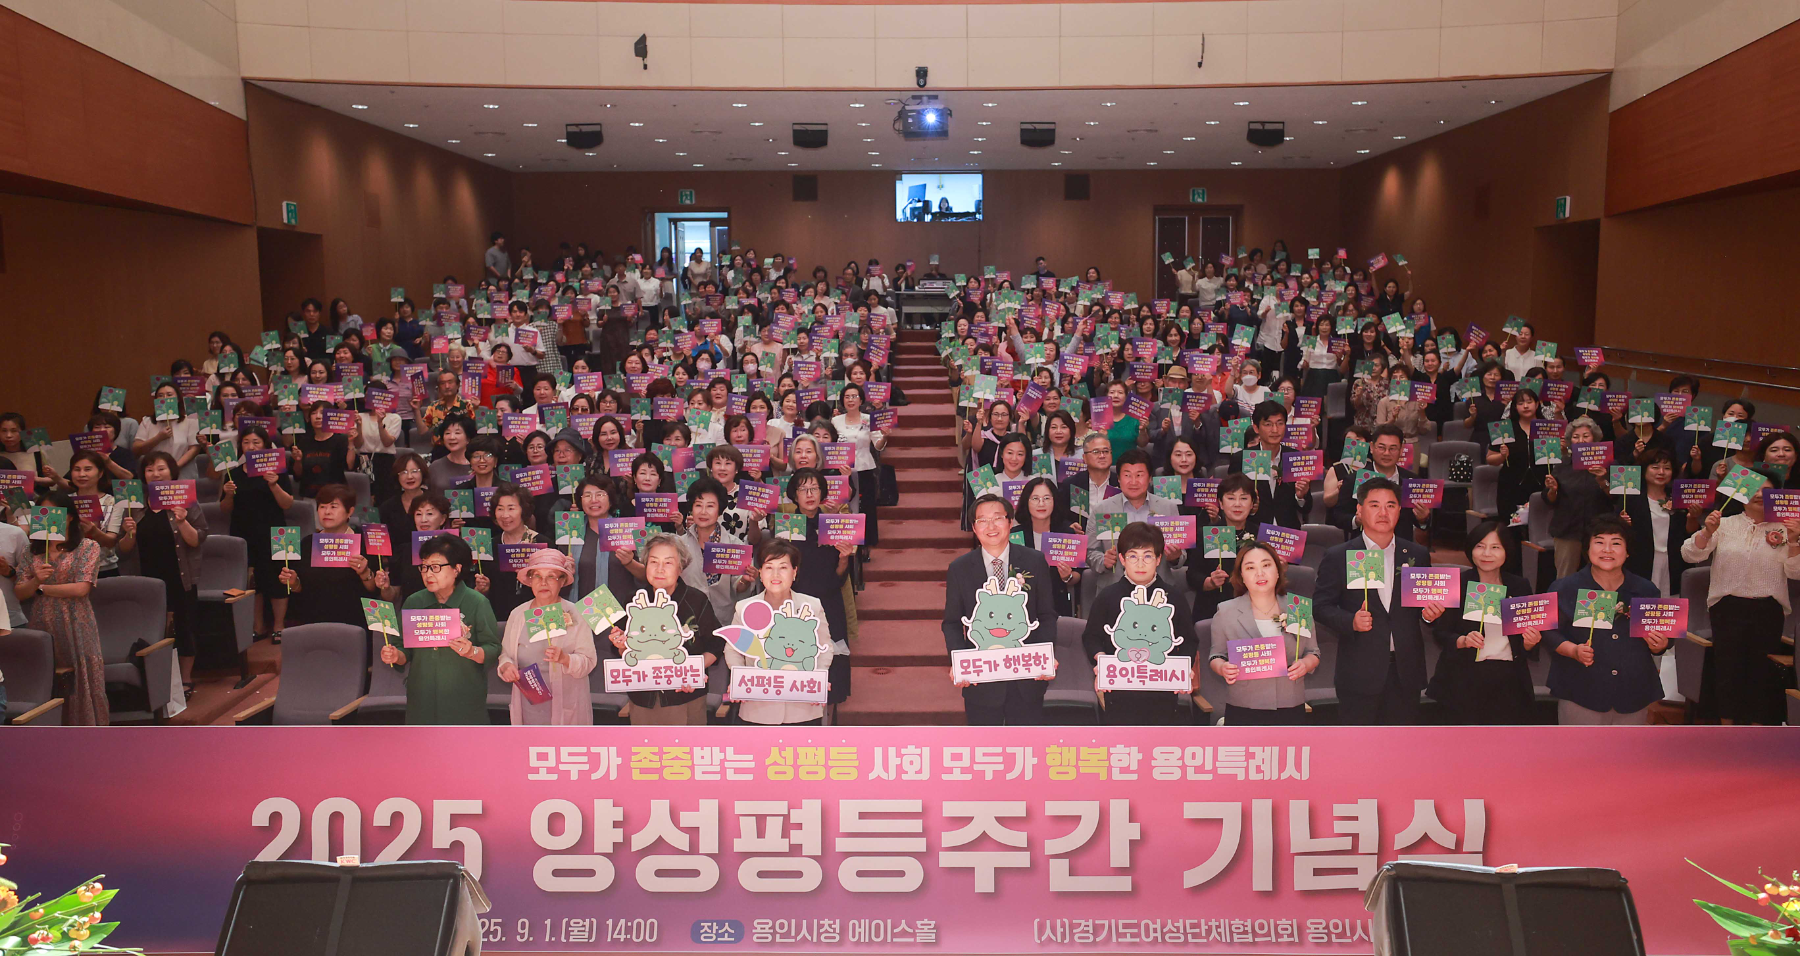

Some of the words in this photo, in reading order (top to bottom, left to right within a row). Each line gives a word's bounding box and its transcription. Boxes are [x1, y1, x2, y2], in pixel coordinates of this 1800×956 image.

[1510, 602, 1526, 610] 모두가
[1528, 599, 1550, 607] 존중받는
[1254, 643, 1277, 651] 존중받는
[610, 668, 648, 685] 모두가
[652, 664, 700, 684] 존중받는
[959, 658, 1000, 677] 모두가
[1002, 652, 1049, 673] 행복한
[1106, 664, 1185, 684] 용인특례시
[738, 676, 785, 696] 성평등
[789, 678, 822, 694] 사회
[528, 746, 622, 781] 모두가
[630, 746, 756, 781] 존중받는
[765, 746, 859, 781] 성평등
[868, 745, 930, 781] 사회
[941, 745, 1038, 781] 모두가
[1046, 745, 1142, 781] 행복한
[1151, 745, 1311, 781] 용인특례시
[251, 797, 483, 883] 2025
[530, 798, 1141, 892] 양성평등주간
[1183, 798, 1486, 892] 기념식
[516, 918, 534, 943] 9.
[606, 918, 658, 943] 14:00
[700, 922, 736, 942] 장소
[752, 918, 841, 943] 용인시청
[848, 918, 936, 943] 에이스홀
[1034, 918, 1299, 944] (사)경기도여성단체협의회
